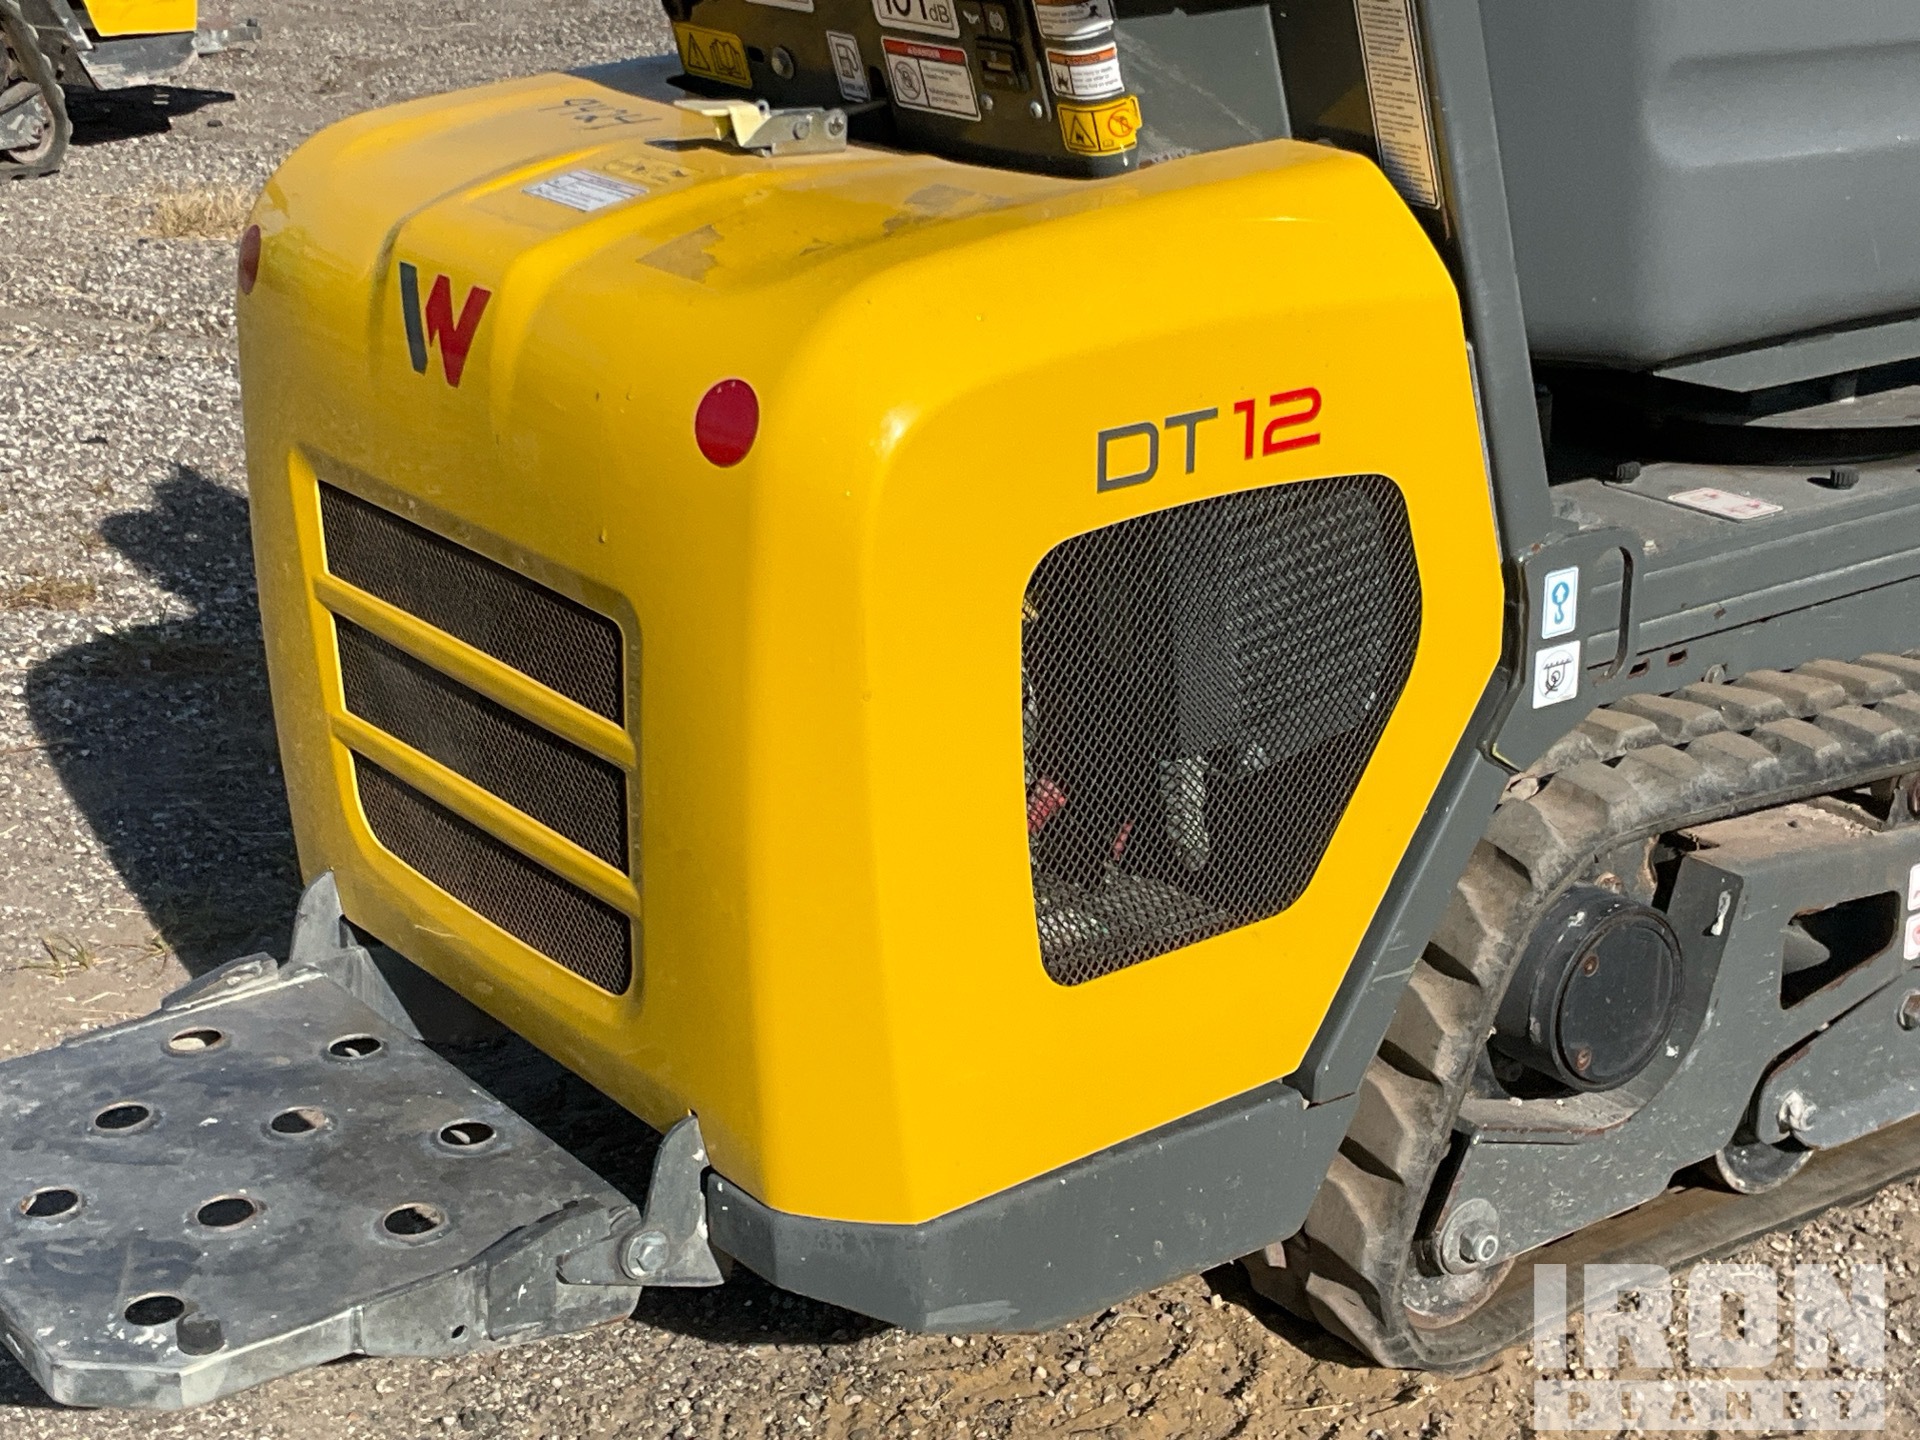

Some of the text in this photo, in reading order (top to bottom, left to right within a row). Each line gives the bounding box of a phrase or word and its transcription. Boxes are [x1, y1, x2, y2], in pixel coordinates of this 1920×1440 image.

[400, 261, 492, 389] W
[1097, 386, 1322, 494] DT 12
